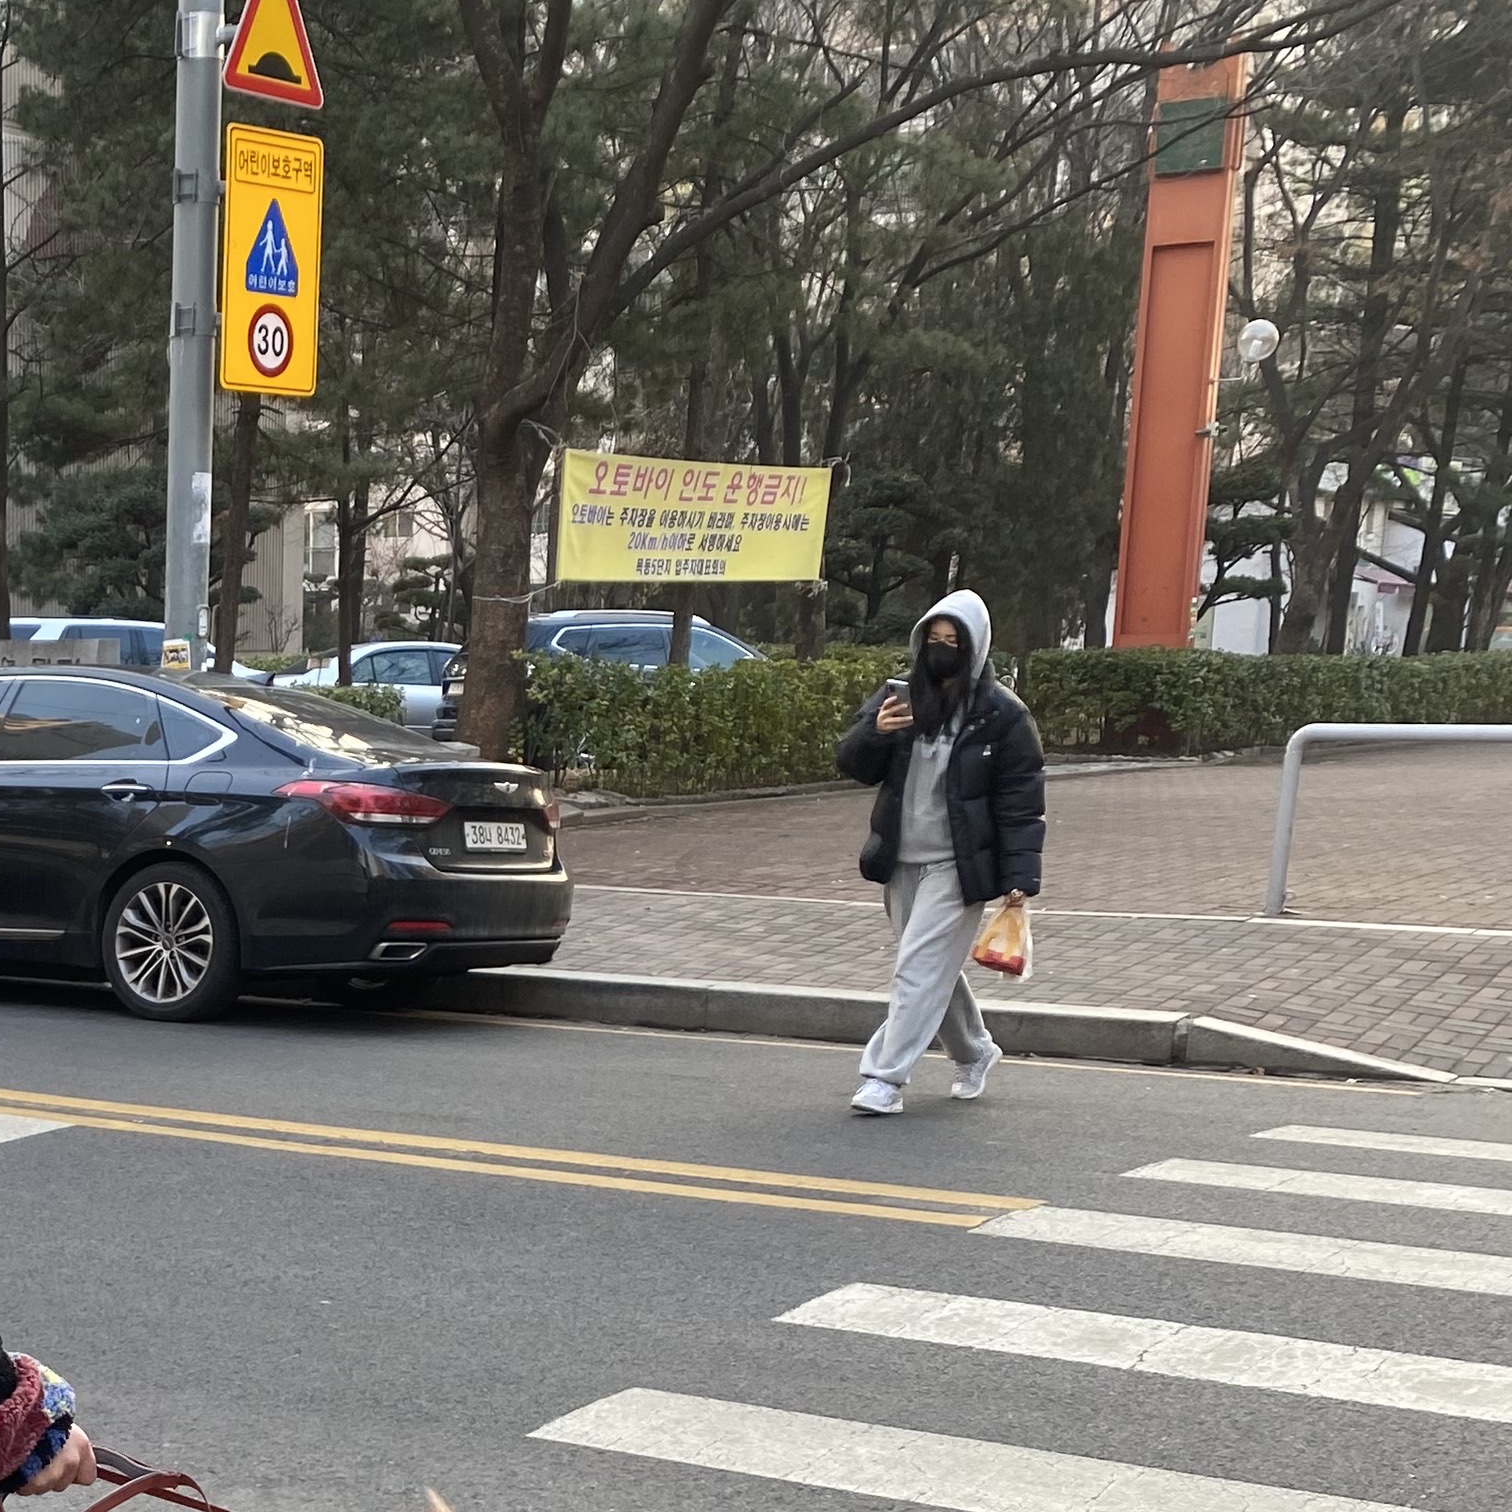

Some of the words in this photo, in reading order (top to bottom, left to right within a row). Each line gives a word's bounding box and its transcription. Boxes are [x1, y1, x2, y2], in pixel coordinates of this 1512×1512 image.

[238, 149, 313, 185] 어린이보호구역
[248, 273, 296, 293] 어린이보호
[257, 323, 284, 357] 30
[588, 460, 675, 501] 오토바이
[679, 468, 720, 502] 인도
[723, 470, 807, 507] 운행금지!
[571, 503, 615, 526] 오토바이는
[620, 507, 656, 528] 주차장을
[659, 509, 705, 530] 이용하시기
[698, 532, 743, 552] 서행하세요
[636, 558, 672, 576] 목동5단지
[496, 826, 522, 846] 8432
